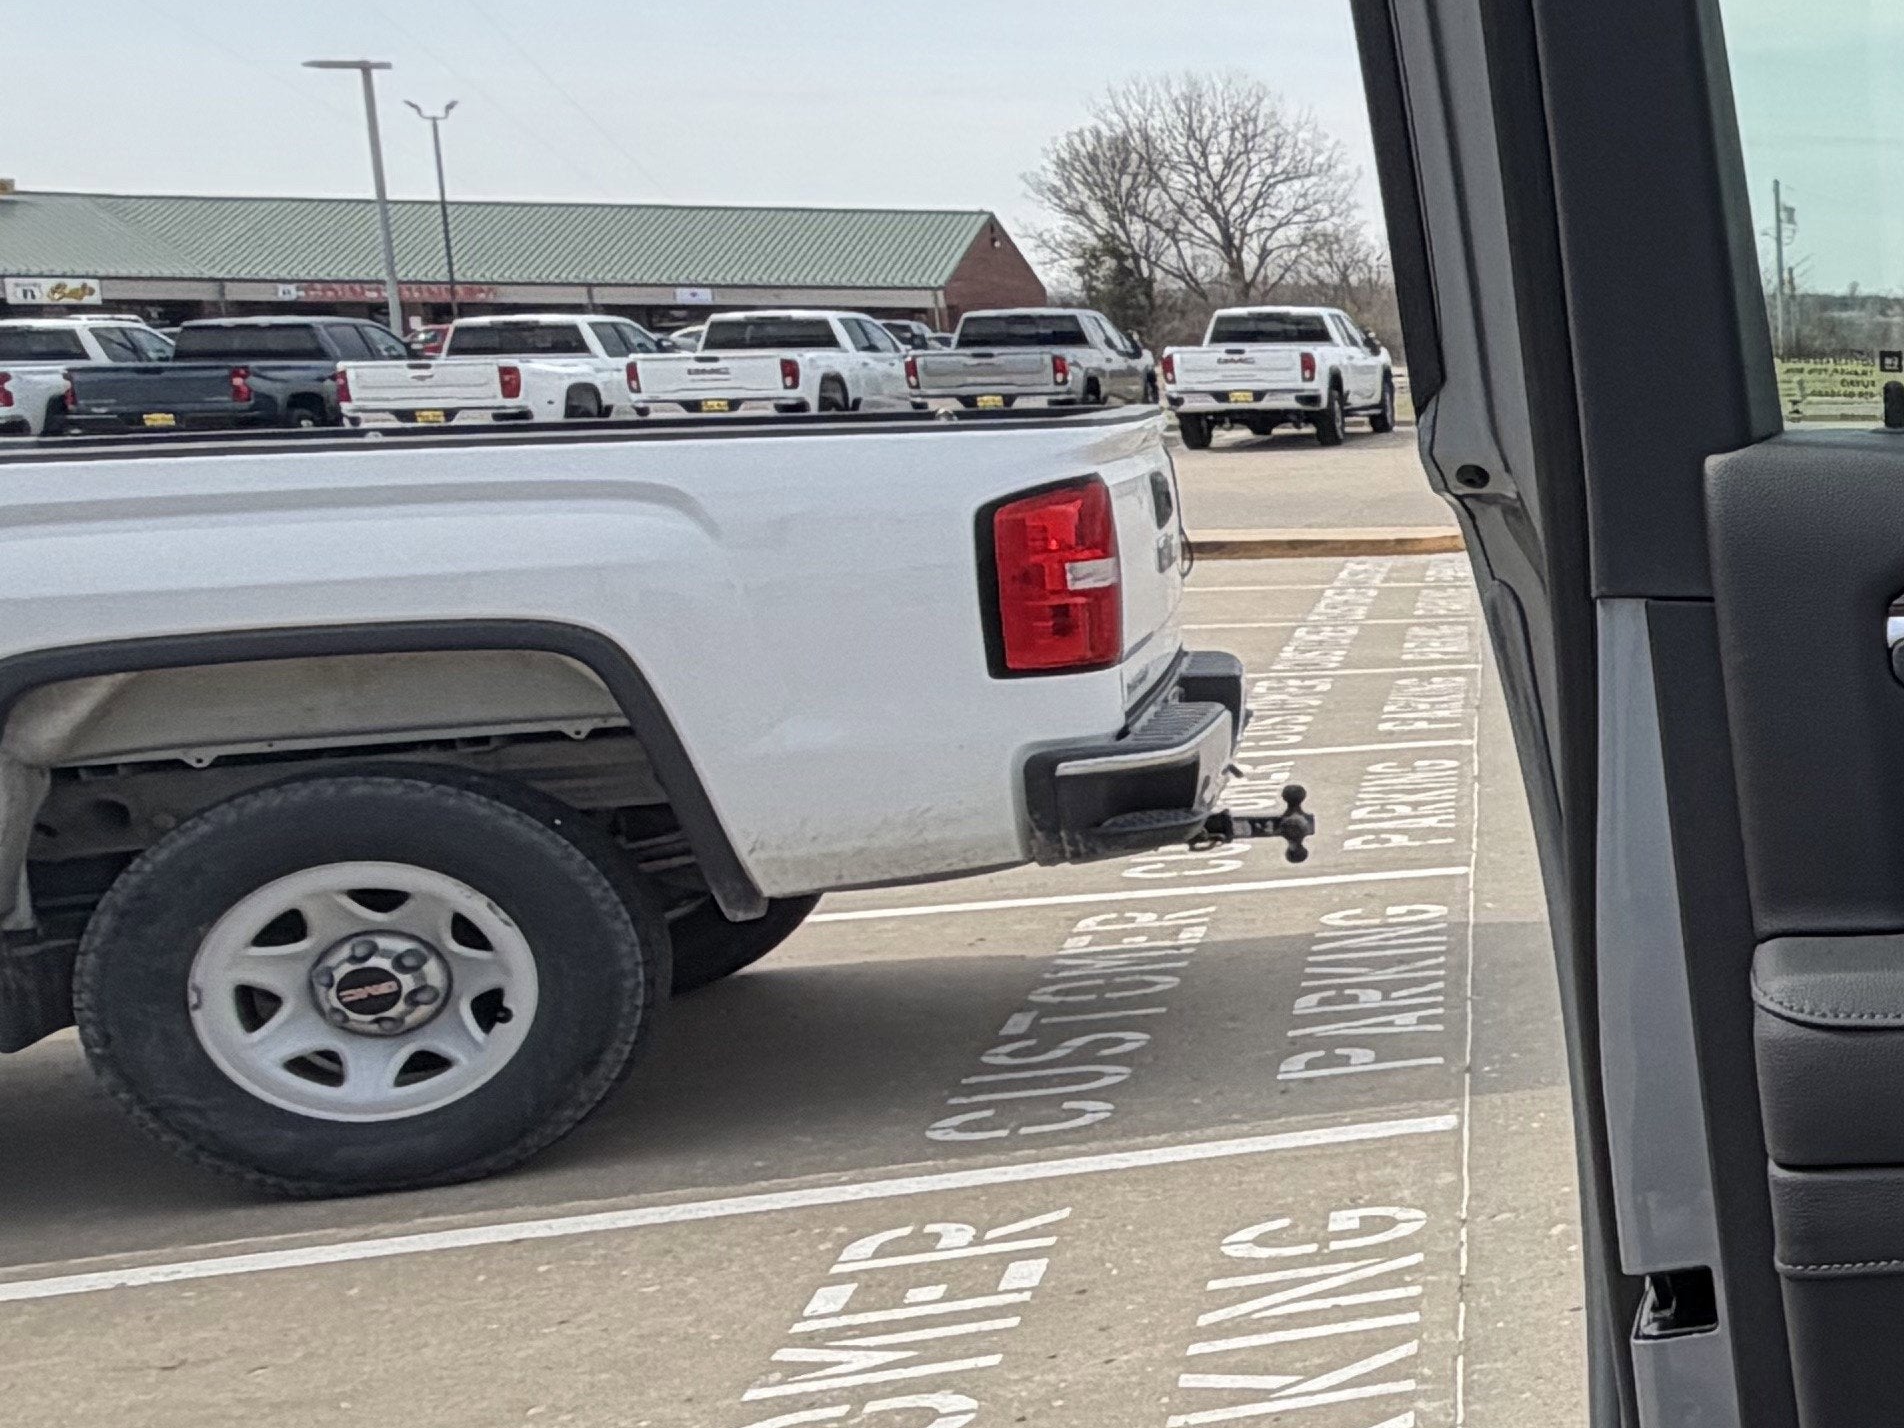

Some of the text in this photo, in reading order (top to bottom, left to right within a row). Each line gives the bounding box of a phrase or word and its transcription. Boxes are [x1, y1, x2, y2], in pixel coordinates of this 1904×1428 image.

[1342, 759, 1461, 852] PARKING
[925, 906, 1217, 1141] CUSTOMER
[1276, 903, 1448, 1080] PARKING
